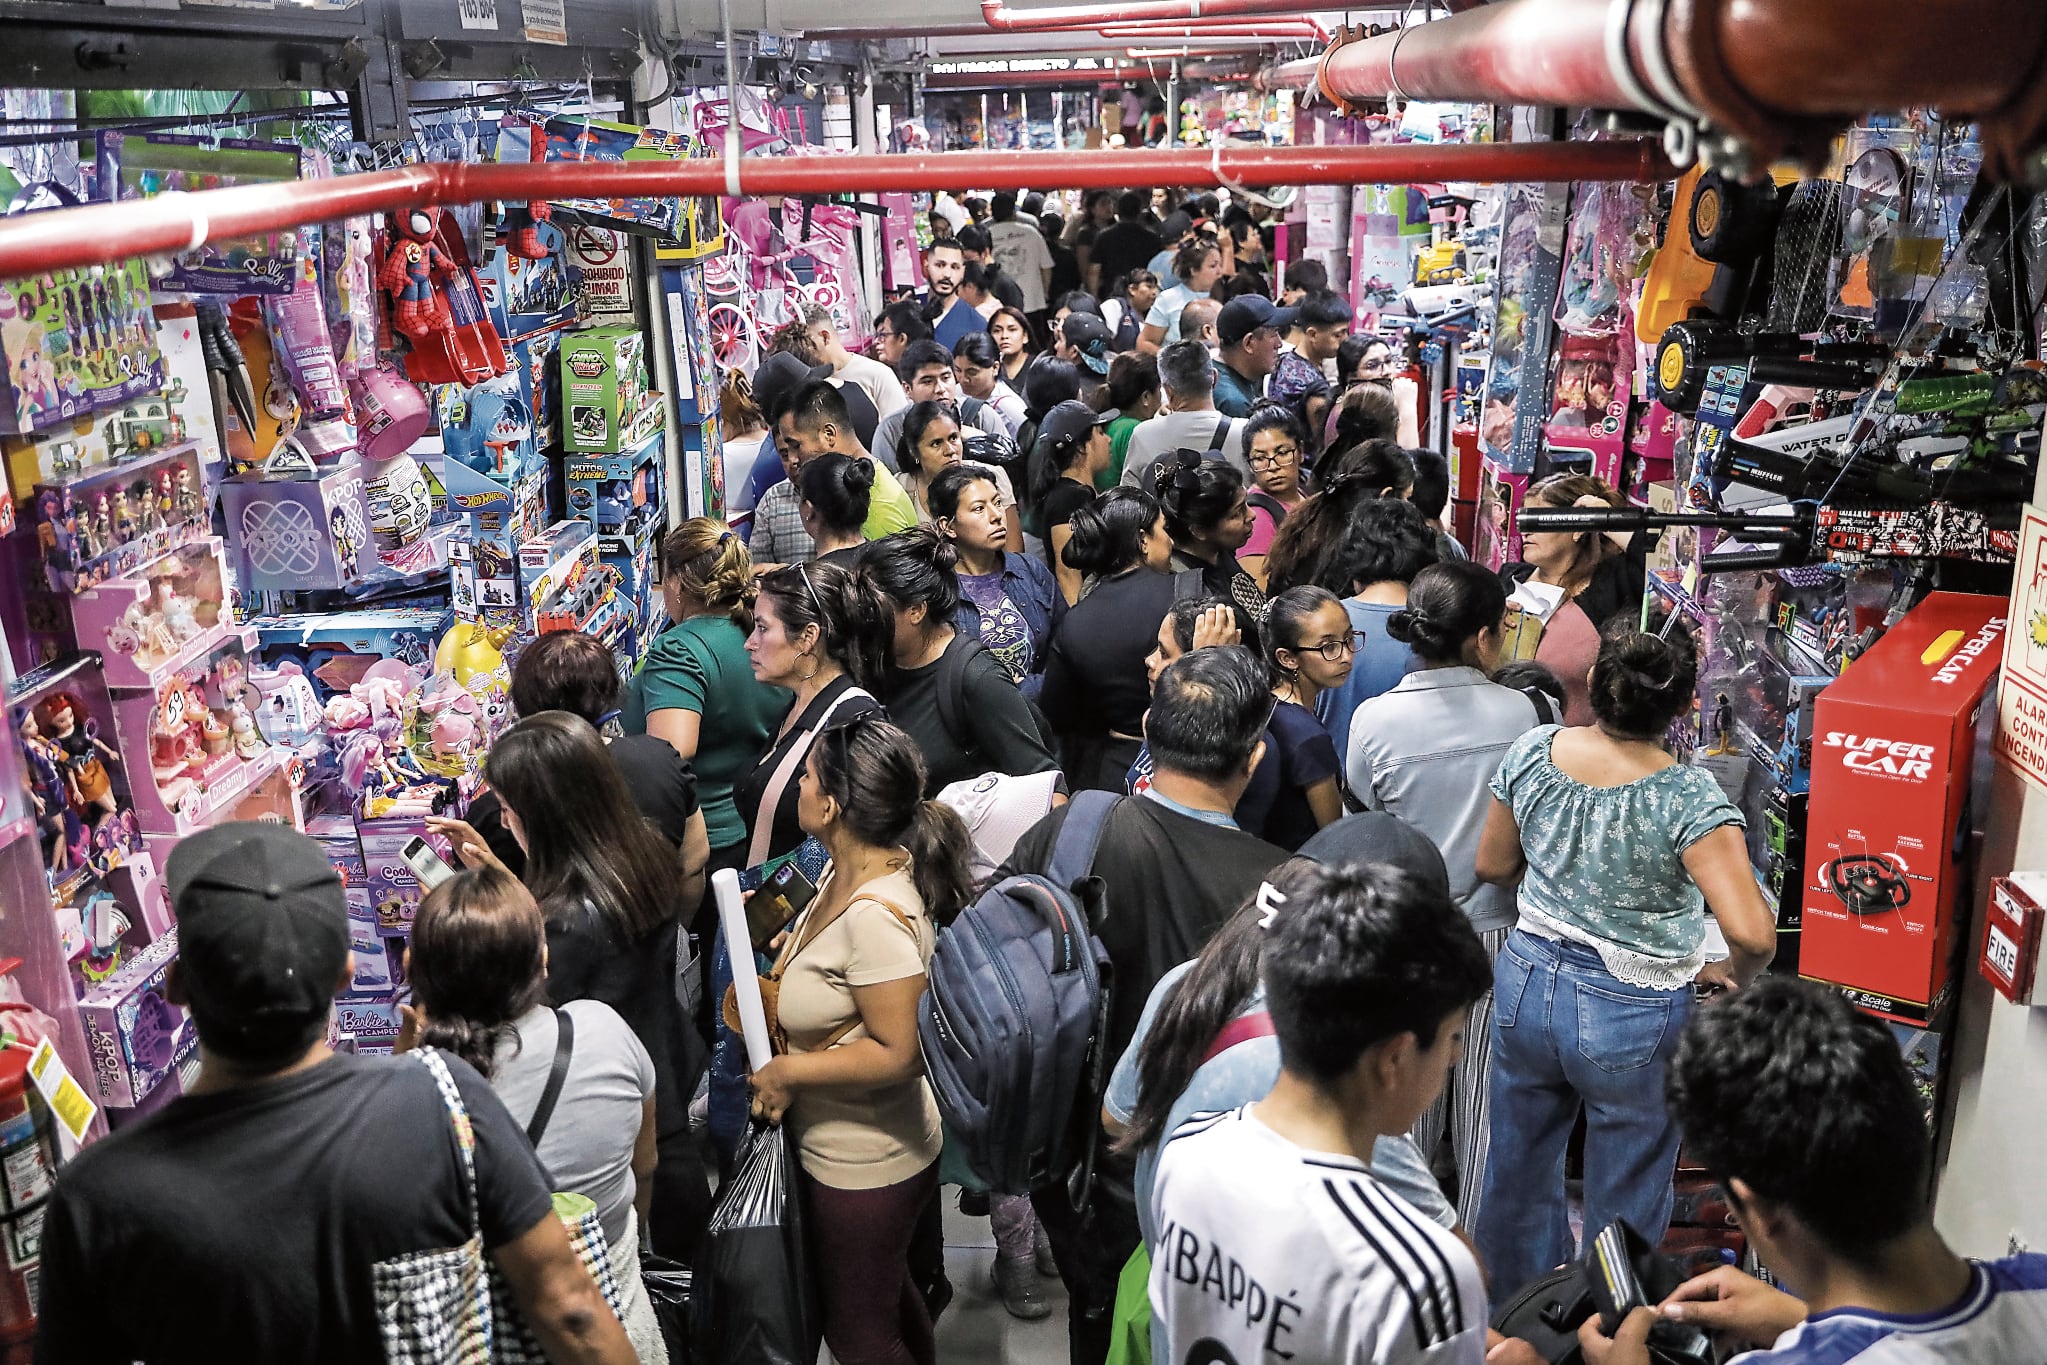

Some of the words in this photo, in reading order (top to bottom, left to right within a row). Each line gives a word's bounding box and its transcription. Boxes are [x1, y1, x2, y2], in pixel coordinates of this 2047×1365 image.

[243, 258, 286, 286] Polly
[582, 267, 625, 281] ROHIBIDO
[120, 350, 153, 387] Polly
[1781, 437, 1831, 453] WATER
[569, 471, 608, 481] EXTREME
[570, 464, 603, 472] MOTOR
[1750, 468, 1783, 482] MUFFLER
[324, 478, 363, 506] KPOP
[466, 494, 481, 508] HOT
[1777, 602, 1796, 635] F1
[183, 630, 207, 658] Dreamy
[1959, 616, 2007, 656] SUPER
[1931, 654, 1972, 685] CAR
[169, 690, 184, 725] 59
[2016, 695, 2047, 728] ALAR
[1822, 731, 1935, 761] SUPER
[1842, 752, 1933, 780] CAR
[212, 768, 243, 799] Dreamy
[1988, 935, 2015, 973] FIRE
[1861, 993, 1891, 1007] Scale
[341, 1010, 386, 1031] Barbie
[87, 1014, 101, 1054] DEMON
[95, 1053, 111, 1098] HUNTERS
[99, 1031, 122, 1082] KPOP
